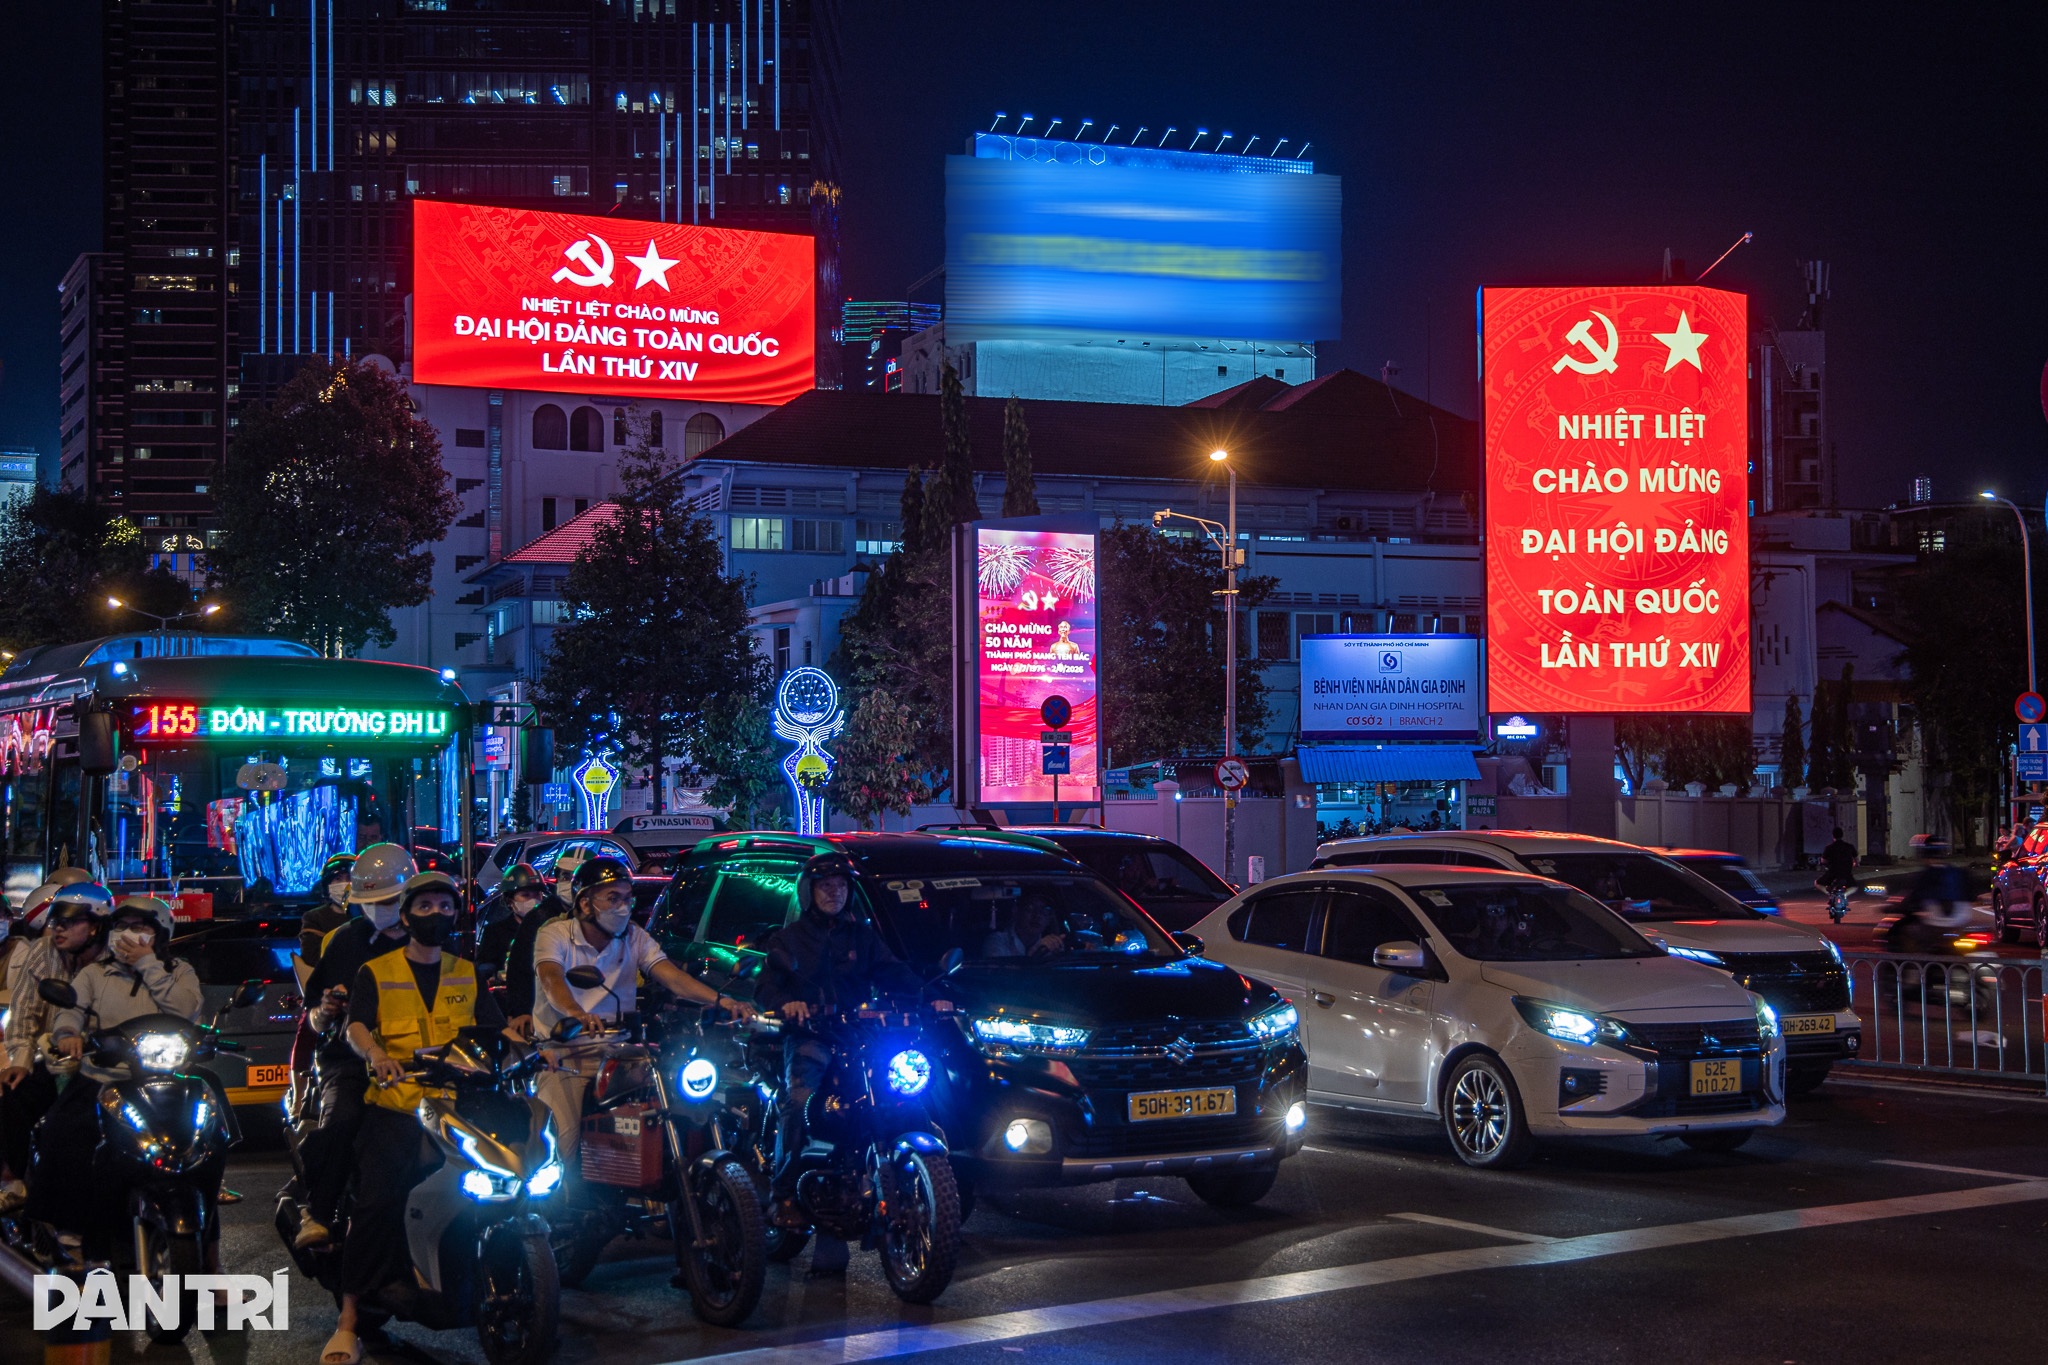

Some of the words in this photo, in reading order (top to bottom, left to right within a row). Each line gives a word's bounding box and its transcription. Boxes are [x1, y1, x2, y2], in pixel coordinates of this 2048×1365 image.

[522, 297, 571, 316] NHIỆT
[576, 299, 611, 319] LIỆT
[615, 302, 666, 321] CHÀO
[670, 306, 719, 325] MỪNG
[455, 315, 500, 341] ĐẠI
[507, 317, 550, 345] HỘI
[555, 319, 627, 347] ĐẢNG
[633, 327, 703, 351] TOÀN
[709, 332, 779, 357] QUỐC
[543, 348, 595, 375] LẦN
[602, 353, 653, 378] THỨ
[659, 361, 698, 381] XIV
[1558, 407, 1644, 446] NHIỆT
[1655, 407, 1706, 446] LIỆT
[1532, 461, 1629, 494] CHÀO
[1639, 460, 1721, 494] MỪNG
[1521, 529, 1575, 561] ĐẠI
[1587, 521, 1643, 561] HỘI
[1654, 518, 1728, 554] ĐẢNG
[1538, 582, 1625, 615] TOÀN
[1635, 578, 1720, 615] QUỐC
[985, 622, 1017, 634] CHÀO
[1019, 622, 1052, 635] MỪNG
[985, 637, 1001, 648] 50
[1003, 635, 1032, 649] NĂM
[1541, 629, 1599, 668] LẦN
[1610, 635, 1670, 668] THỨ
[1679, 642, 1720, 668] XIV
[1313, 677, 1341, 698] BỆNH
[1343, 677, 1365, 698] VIỆN
[1367, 677, 1396, 694] NHÂN
[1397, 677, 1419, 694] DÂN
[1421, 679, 1438, 694] GIA
[1440, 679, 1465, 698] ĐỊNH
[1313, 702, 1344, 711] NHAN
[1346, 702, 1368, 711] DAN
[1370, 702, 1388, 711] GIA
[1390, 702, 1415, 711] DINH
[1417, 701, 1465, 711] HOSPITAL
[149, 706, 196, 734] 155
[284, 706, 386, 733] TRƯỜNG
[390, 711, 423, 733] ĐH
[1346, 716, 1361, 726] CƠ
[1361, 714, 1376, 726] SỞ
[1376, 716, 1383, 725] 2
[1400, 716, 1436, 726] BRANCH
[1437, 716, 1443, 725] 2
[445, 995, 468, 1004] TADA
[1705, 1062, 1727, 1076] 62E
[1696, 1077, 1735, 1094] 010.27
[1138, 1093, 1226, 1115] 50H-391.67
